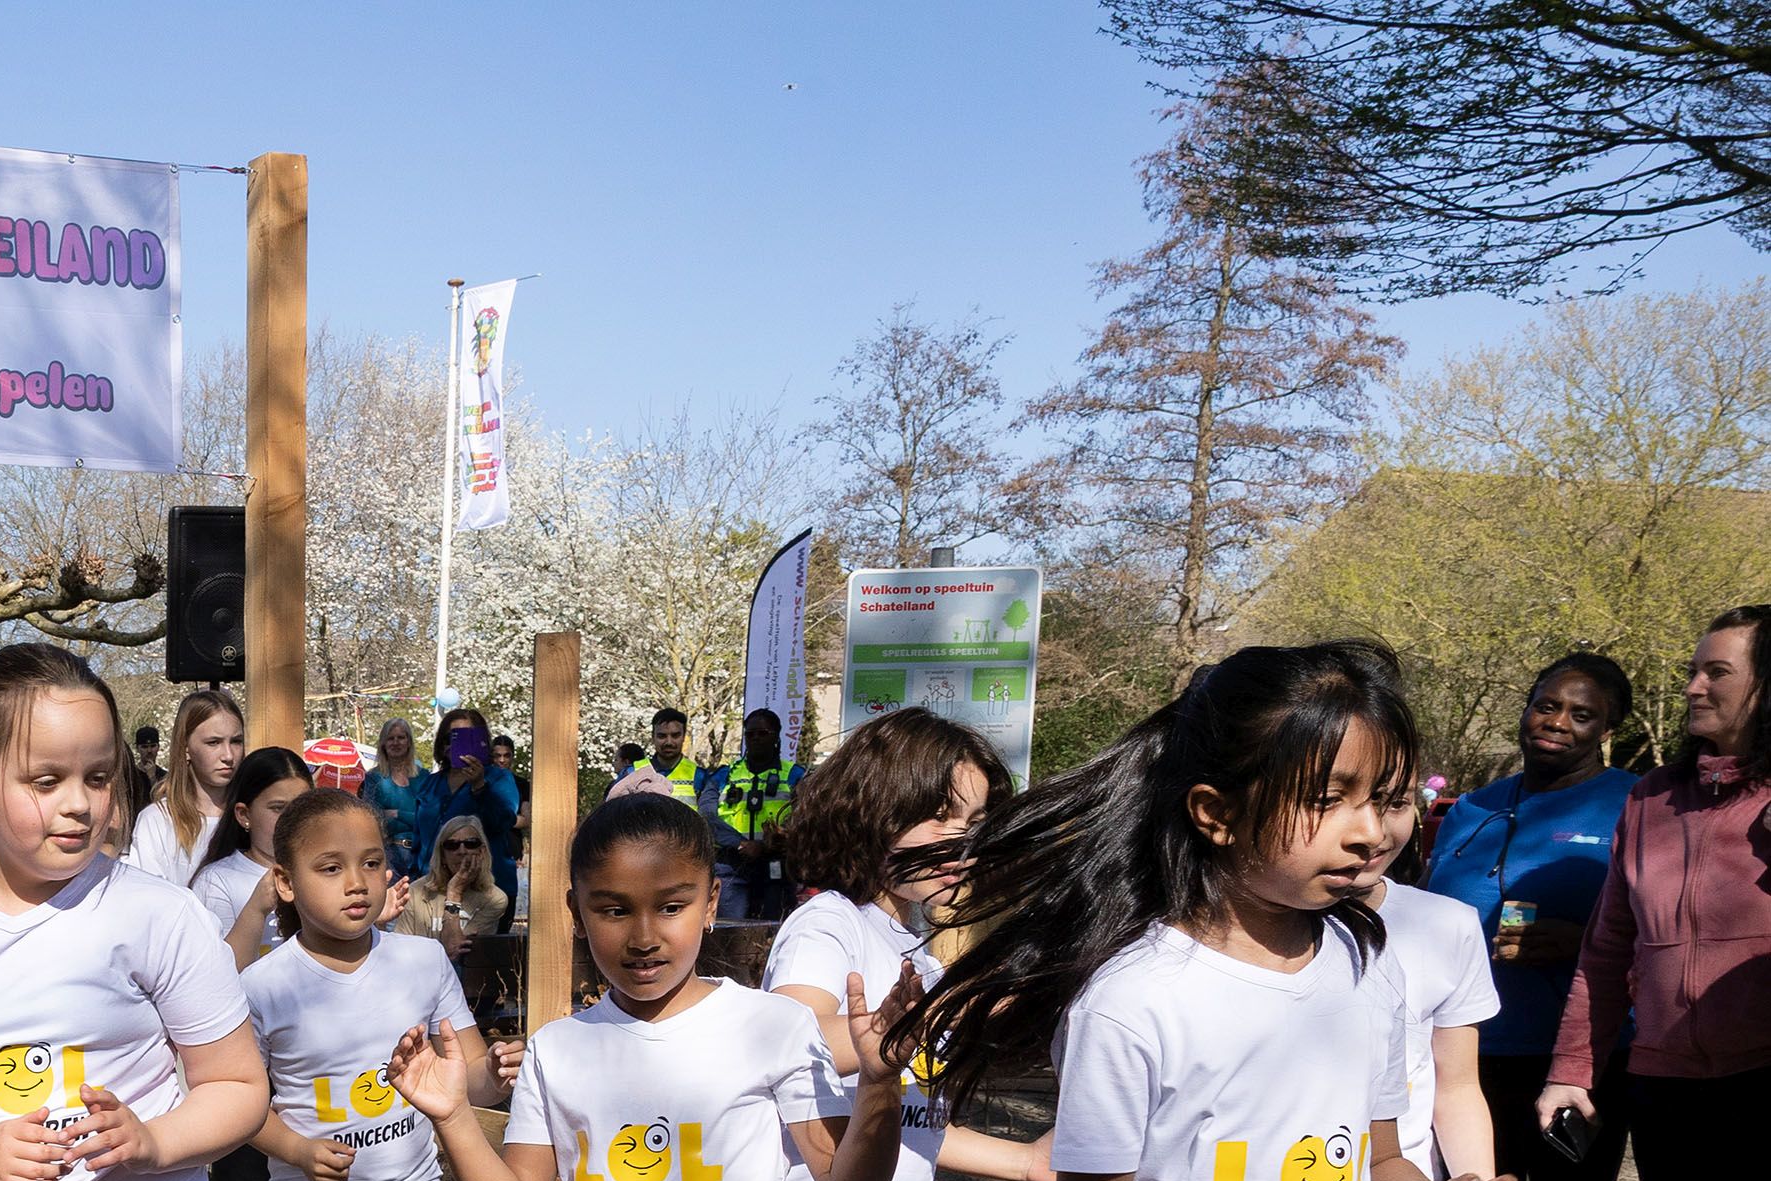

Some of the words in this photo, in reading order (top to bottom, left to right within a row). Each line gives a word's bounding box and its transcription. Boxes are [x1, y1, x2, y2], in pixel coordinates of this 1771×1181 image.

[861, 585, 911, 595] Welkom
[915, 586, 931, 596] op
[934, 583, 994, 595] speeltuin
[860, 601, 934, 613] Schateiland
[333, 1112, 415, 1149] DANCECREW
